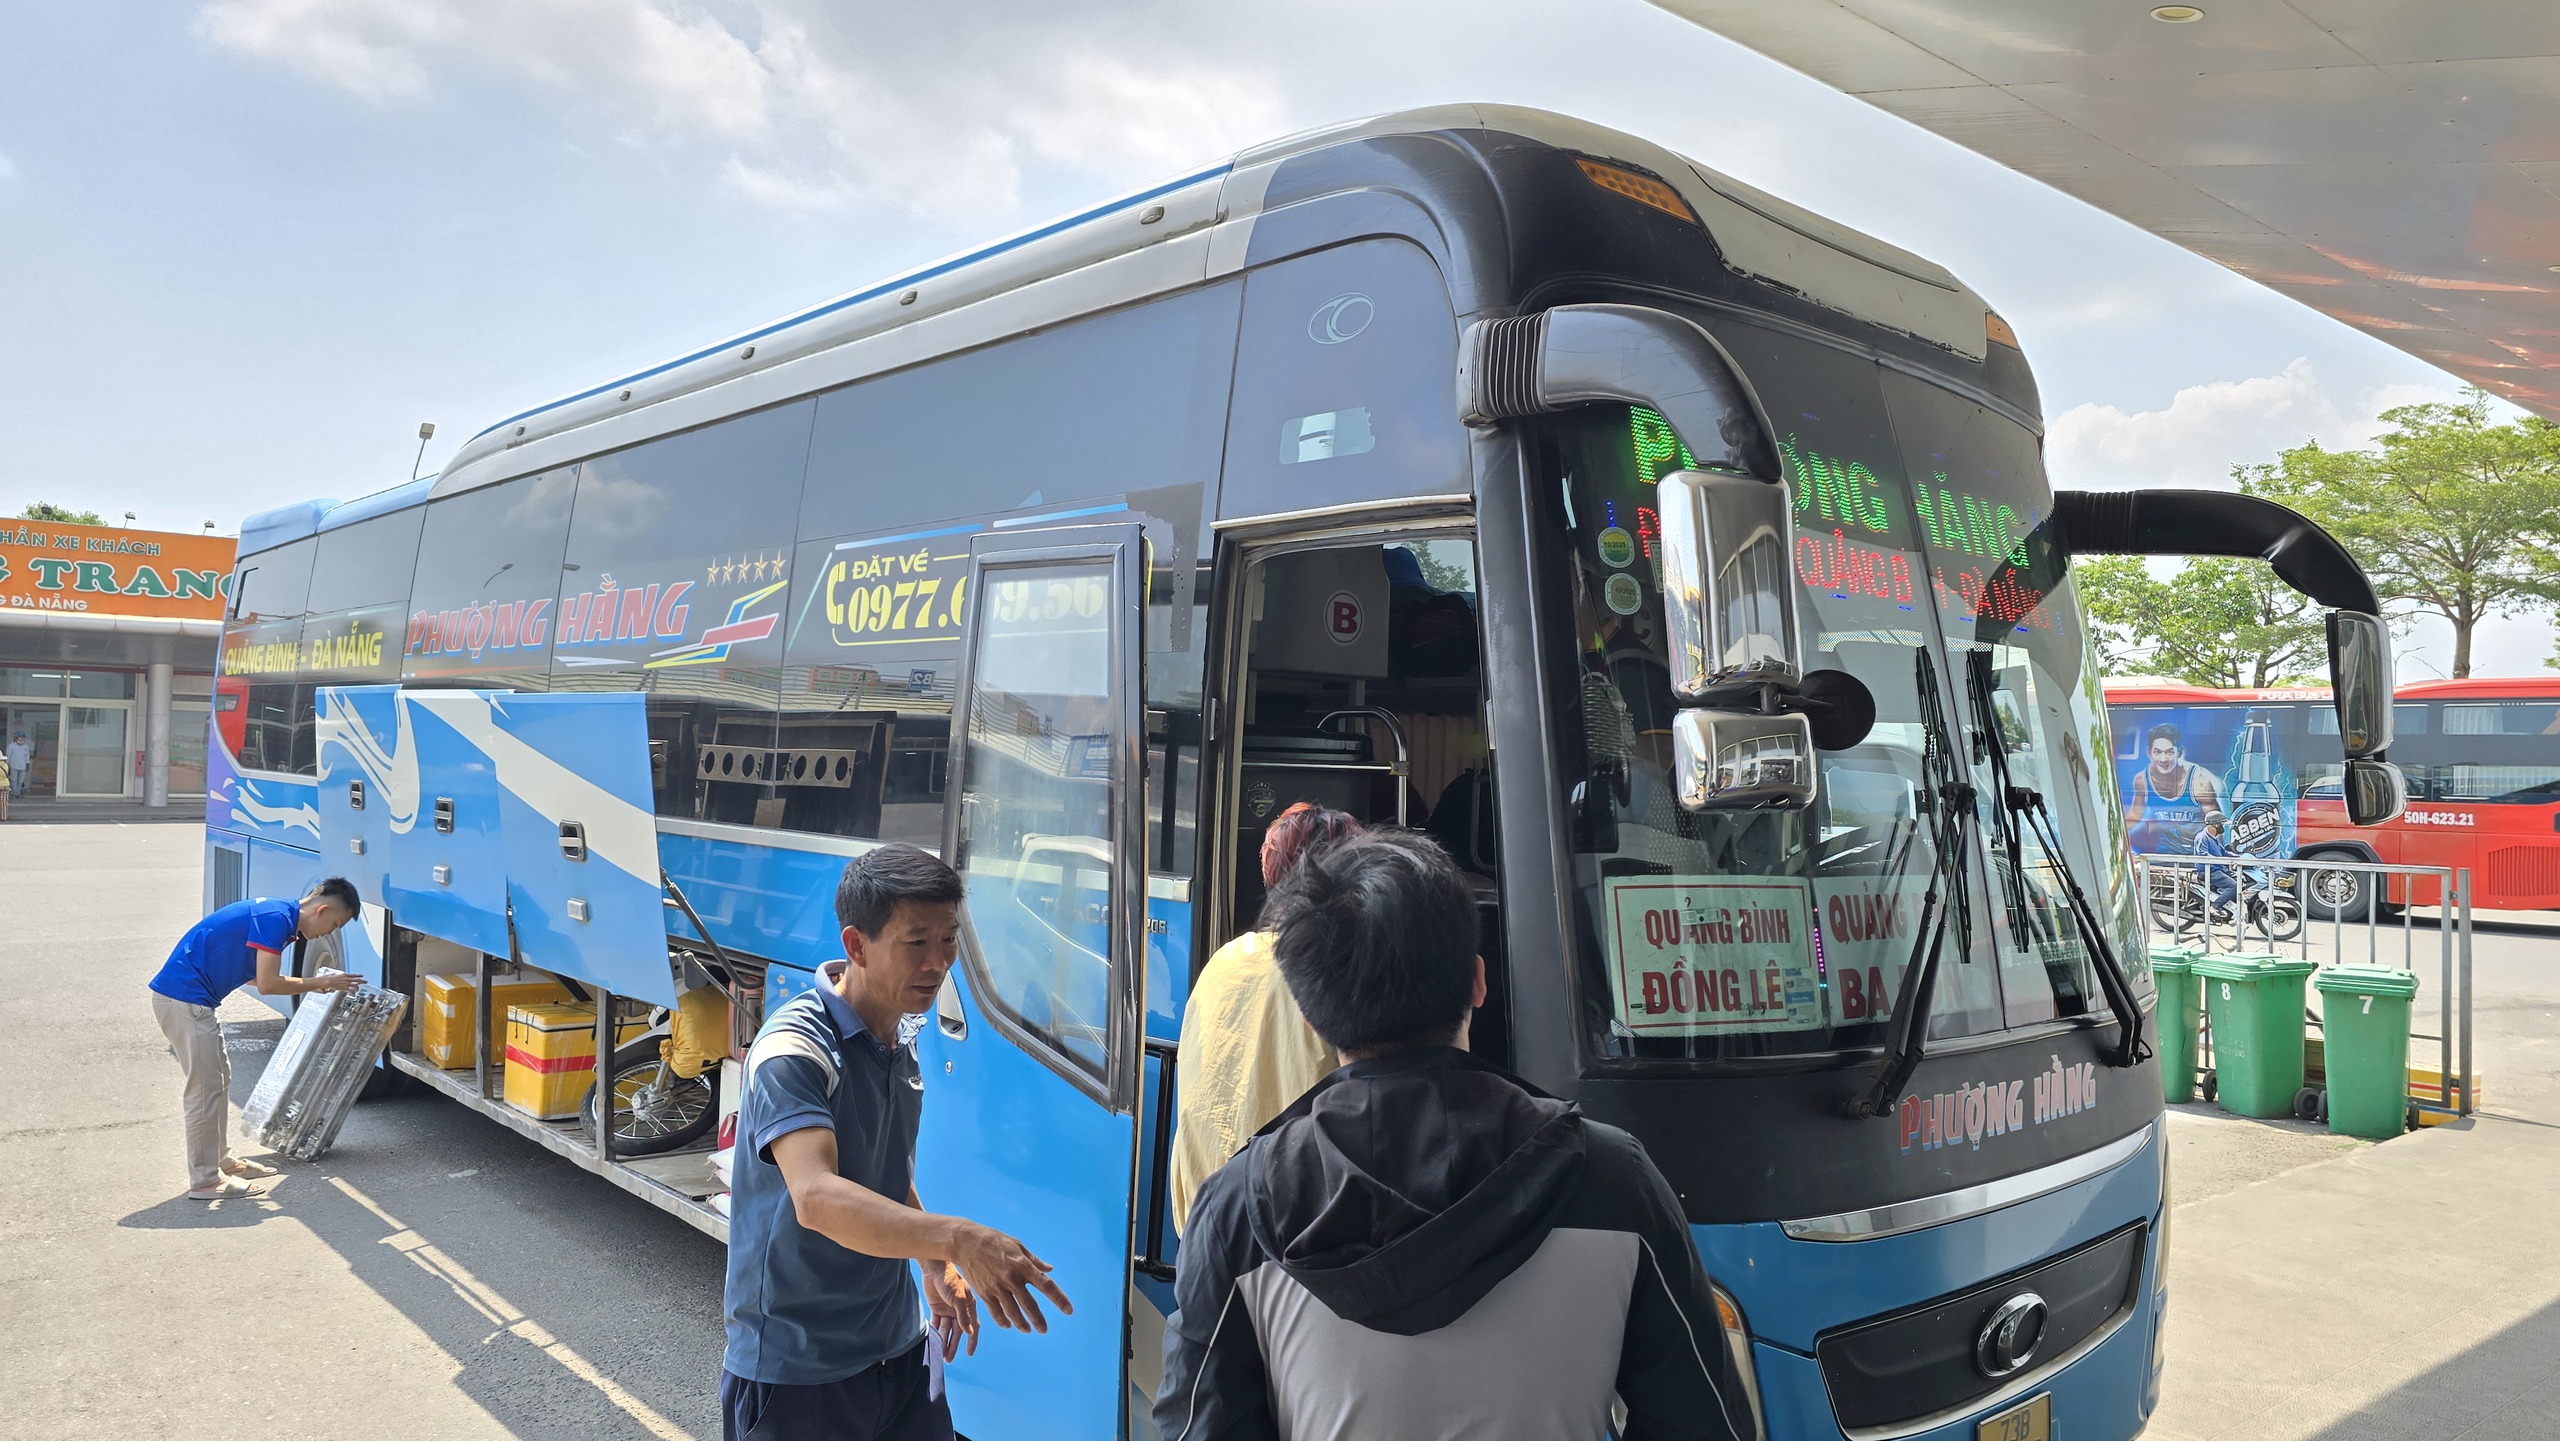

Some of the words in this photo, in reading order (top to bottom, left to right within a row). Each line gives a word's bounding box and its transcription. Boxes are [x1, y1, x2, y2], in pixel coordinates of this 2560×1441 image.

[53, 534, 80, 550] XE
[86, 537, 161, 556] KHÁCH
[1603, 540, 1627, 549] 10/2025
[852, 554, 896, 582] ĐẶT
[898, 547, 929, 574] VÉ
[11, 592, 35, 608] ĐÀ
[39, 592, 88, 611] NẴNG
[403, 598, 553, 664] PHƯỢNG
[554, 572, 696, 647] HẰNG
[1332, 602, 1357, 634] B
[225, 639, 265, 676] QUẢNG
[264, 636, 298, 673] BÌNH
[311, 629, 332, 670] ĐÀ
[333, 619, 383, 669] NẴNG
[2230, 807, 2280, 844] ABBEN
[2404, 811, 2475, 826] 50H-623.21
[1644, 896, 1734, 950] QUẢNG
[1738, 901, 1791, 944] BÌNH
[1828, 881, 1908, 945] QUẢNG
[1642, 955, 1742, 1015] ĐỒNG
[1749, 959, 1784, 1011] LÊ
[1838, 966, 1892, 1020] BA
[2220, 982, 2232, 1001] 8
[2358, 995, 2374, 1015] 7
[1900, 1080, 2024, 1155] PHƯỢNG
[2033, 1053, 2097, 1125] HẰNG
